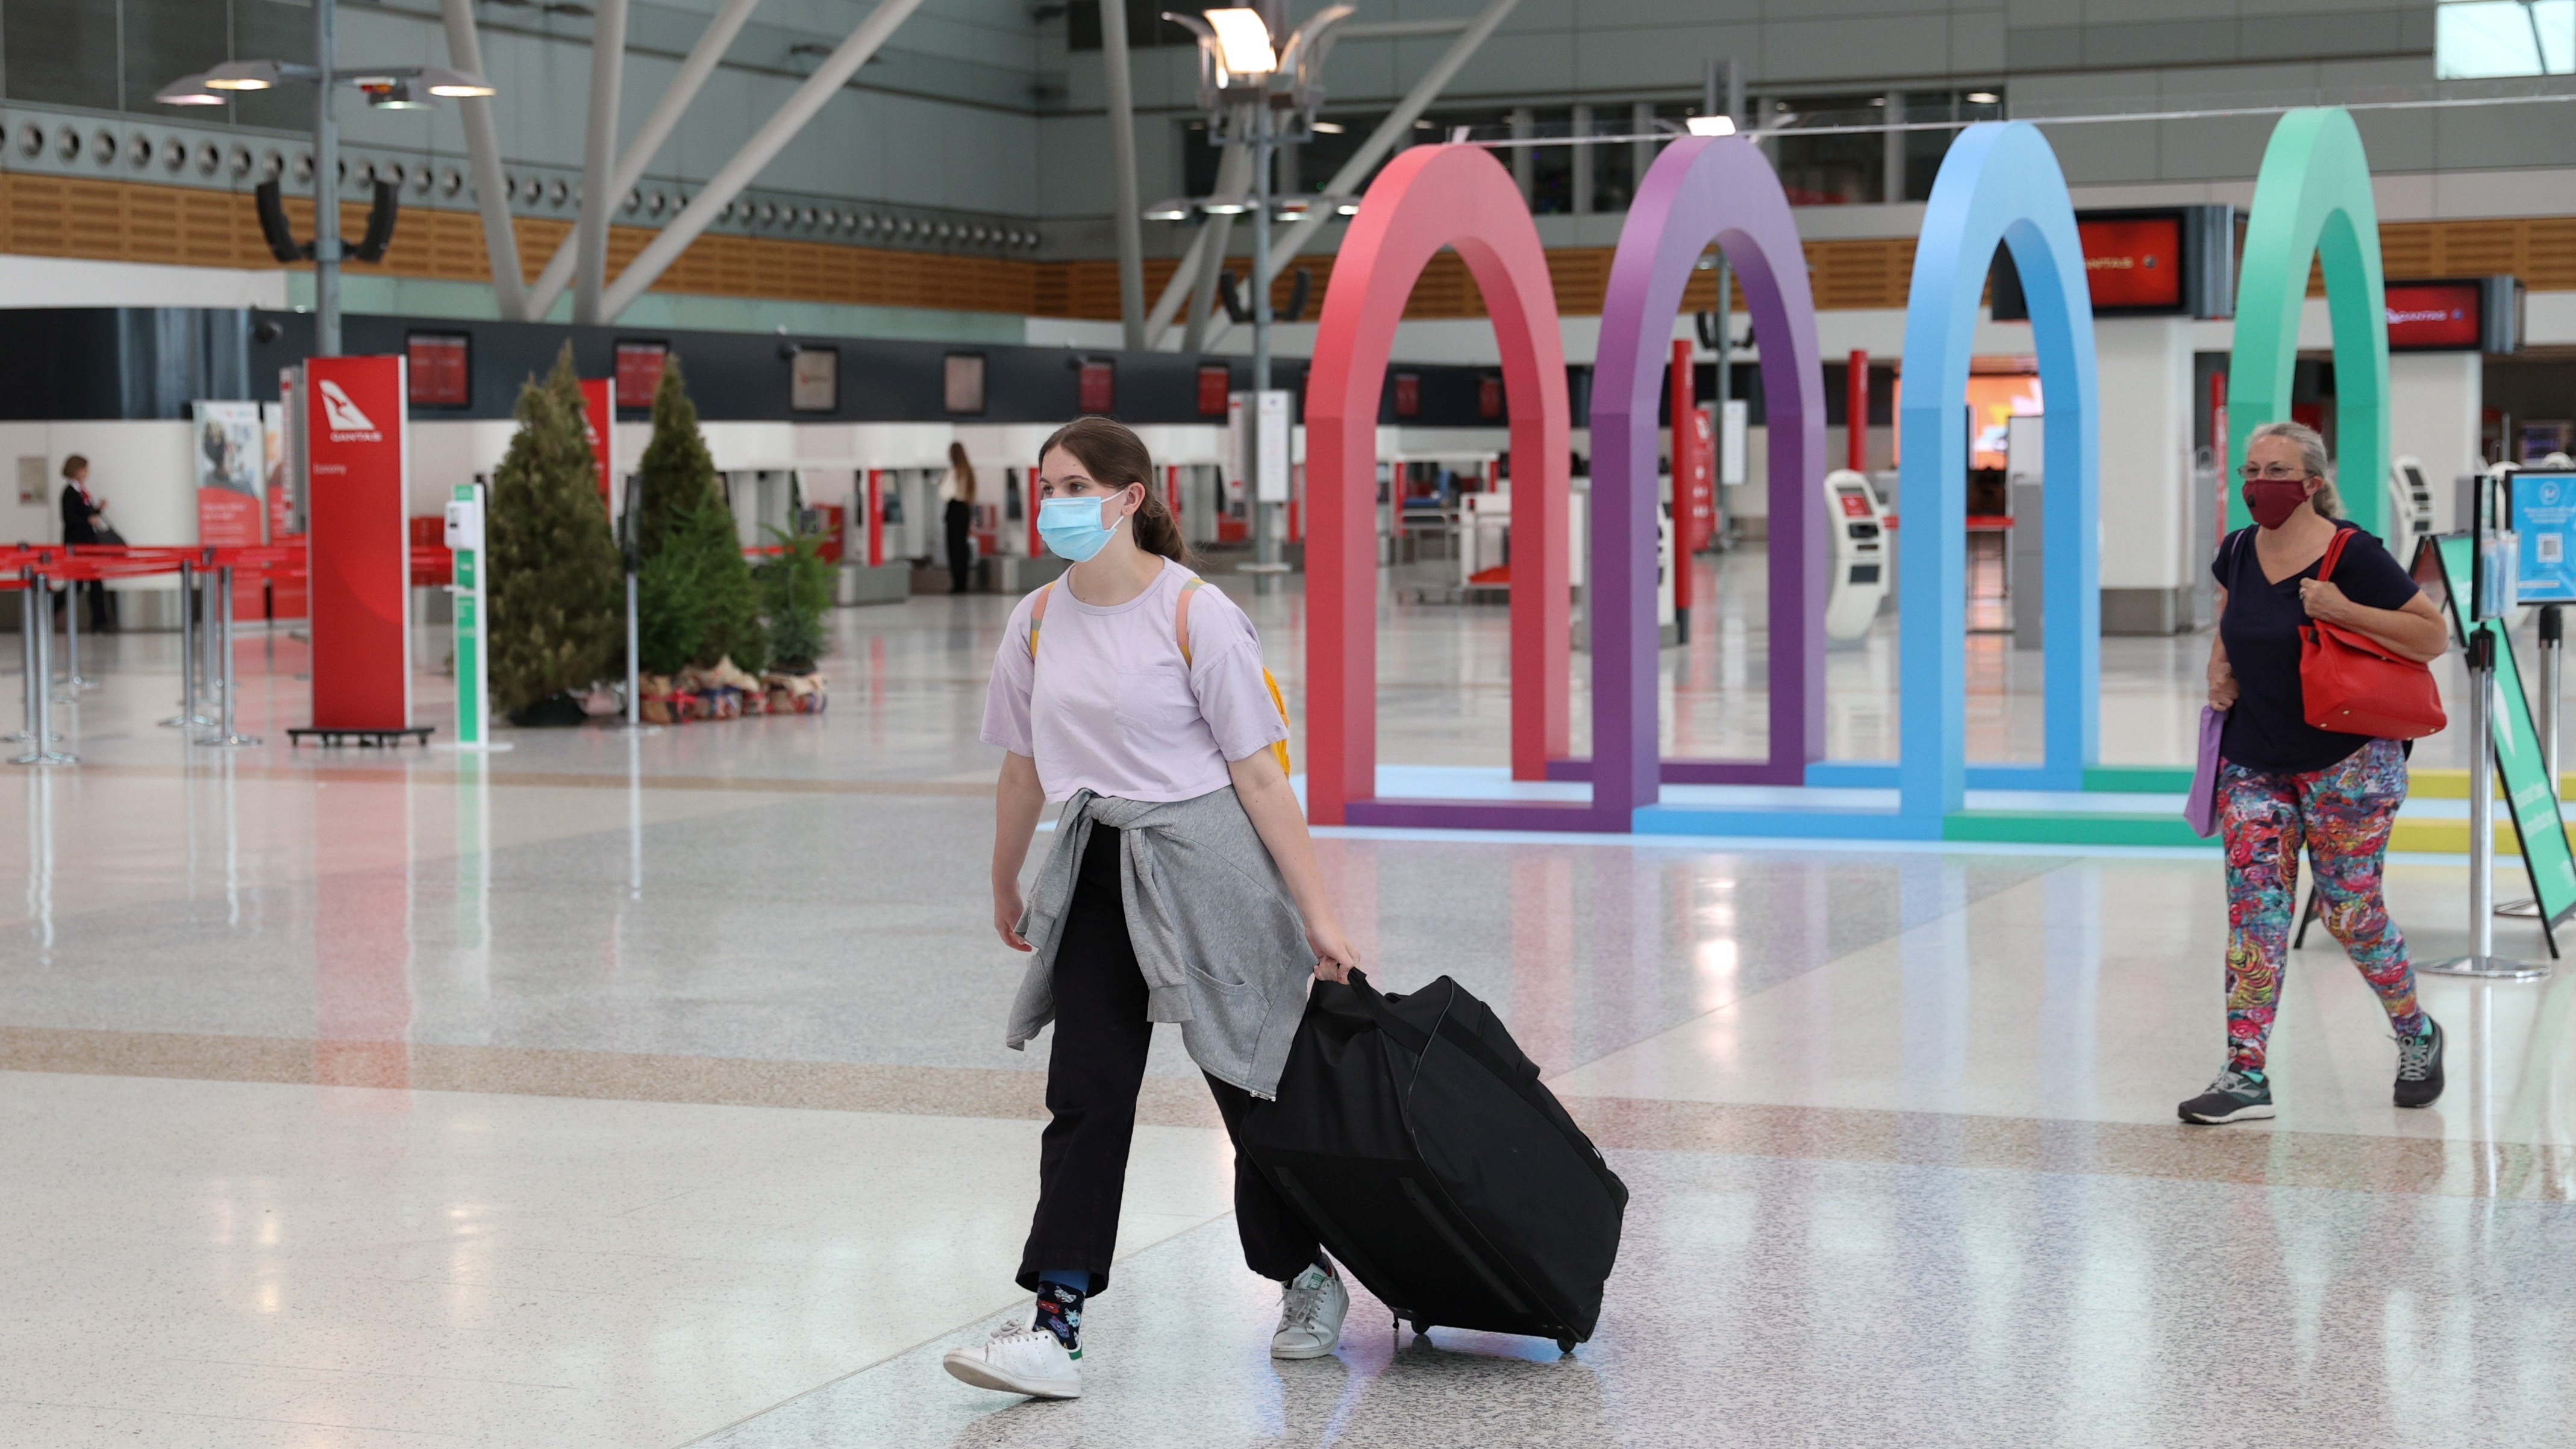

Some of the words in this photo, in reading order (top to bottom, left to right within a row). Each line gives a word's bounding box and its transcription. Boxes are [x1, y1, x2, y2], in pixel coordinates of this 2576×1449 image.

[2085, 257, 2134, 270] ANTAS
[2396, 311, 2447, 321] QANTAS
[330, 431, 383, 442] QANTAS
[313, 464, 347, 477] Economy
